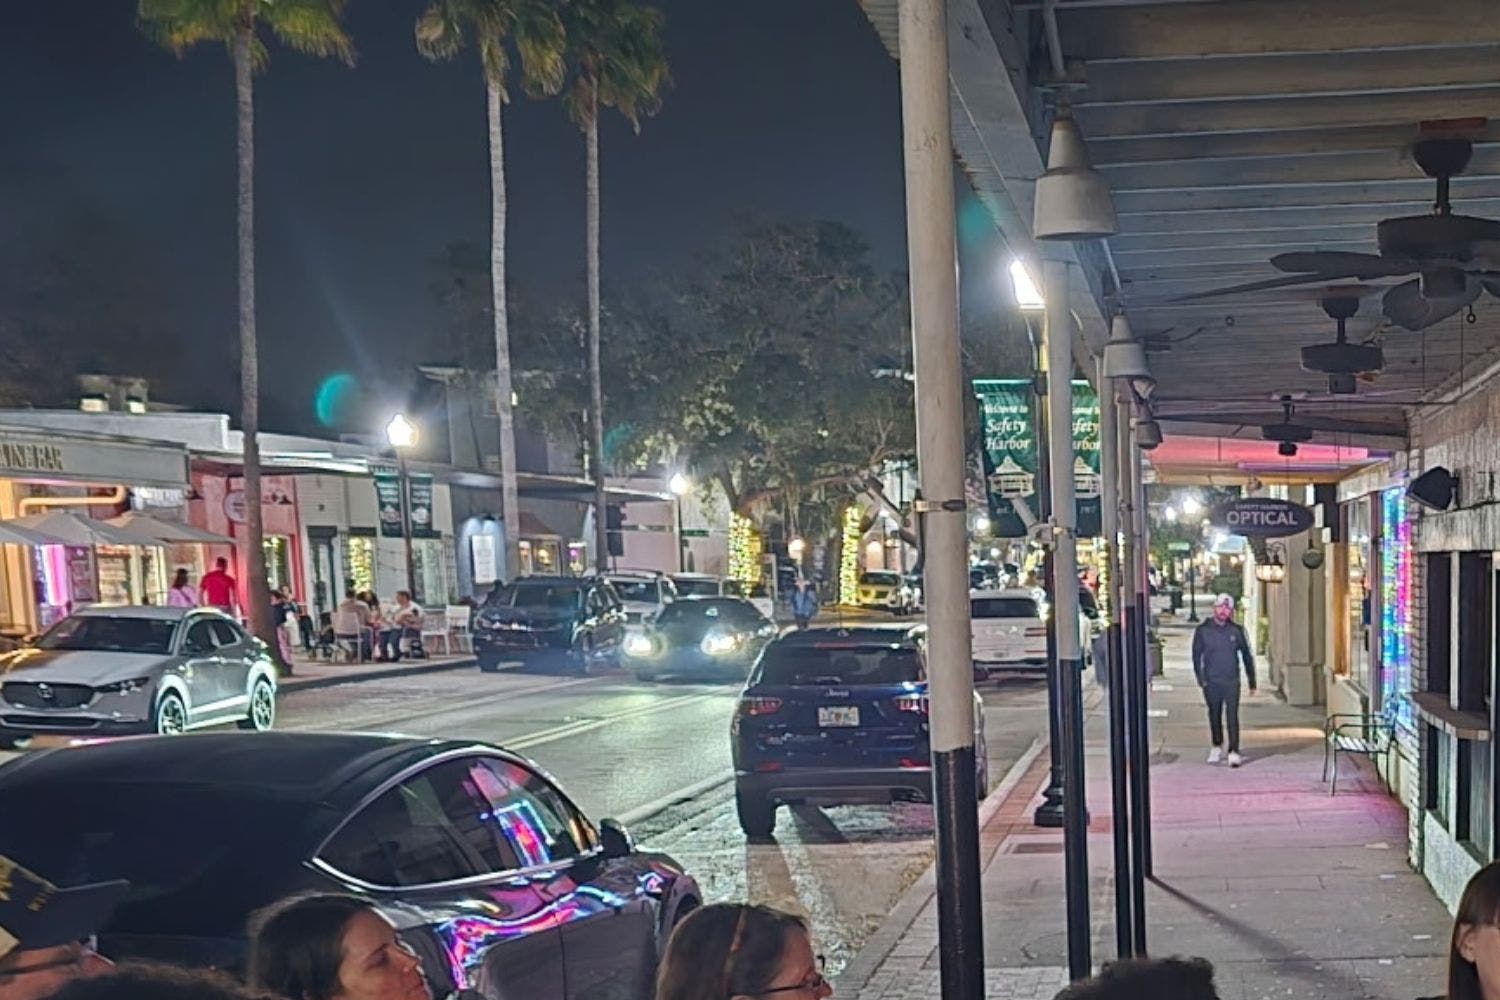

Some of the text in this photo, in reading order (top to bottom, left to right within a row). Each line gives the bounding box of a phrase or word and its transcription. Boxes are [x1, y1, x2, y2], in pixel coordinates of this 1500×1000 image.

[985, 416, 1027, 436] Safety
[984, 436, 1031, 450] Harbor
[1226, 511, 1298, 526] OPTICAL
